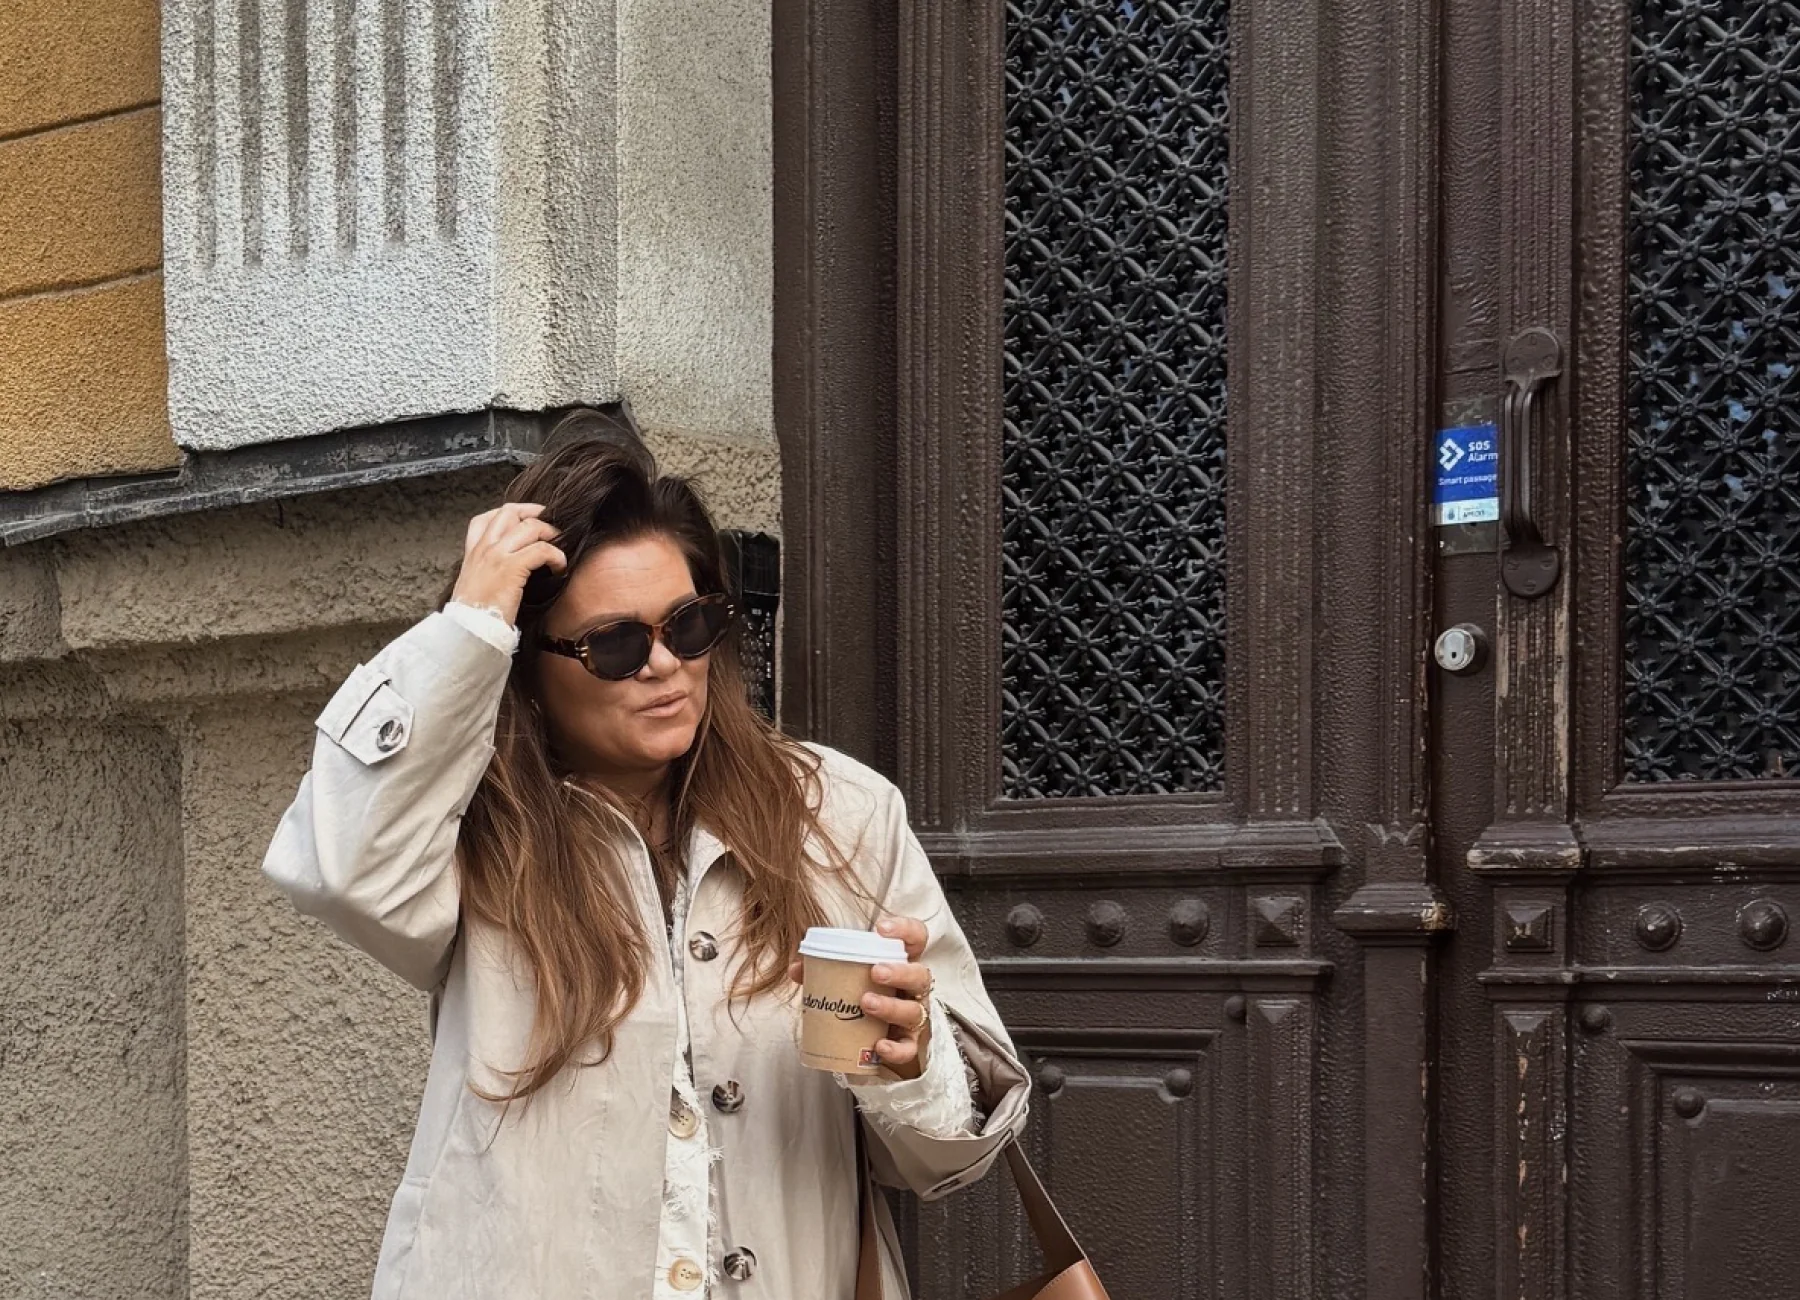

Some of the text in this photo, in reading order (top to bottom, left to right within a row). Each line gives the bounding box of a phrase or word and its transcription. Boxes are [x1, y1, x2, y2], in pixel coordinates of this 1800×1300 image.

[1467, 452, 1499, 463] Alarm
[1438, 473, 1497, 486] Smart passage
